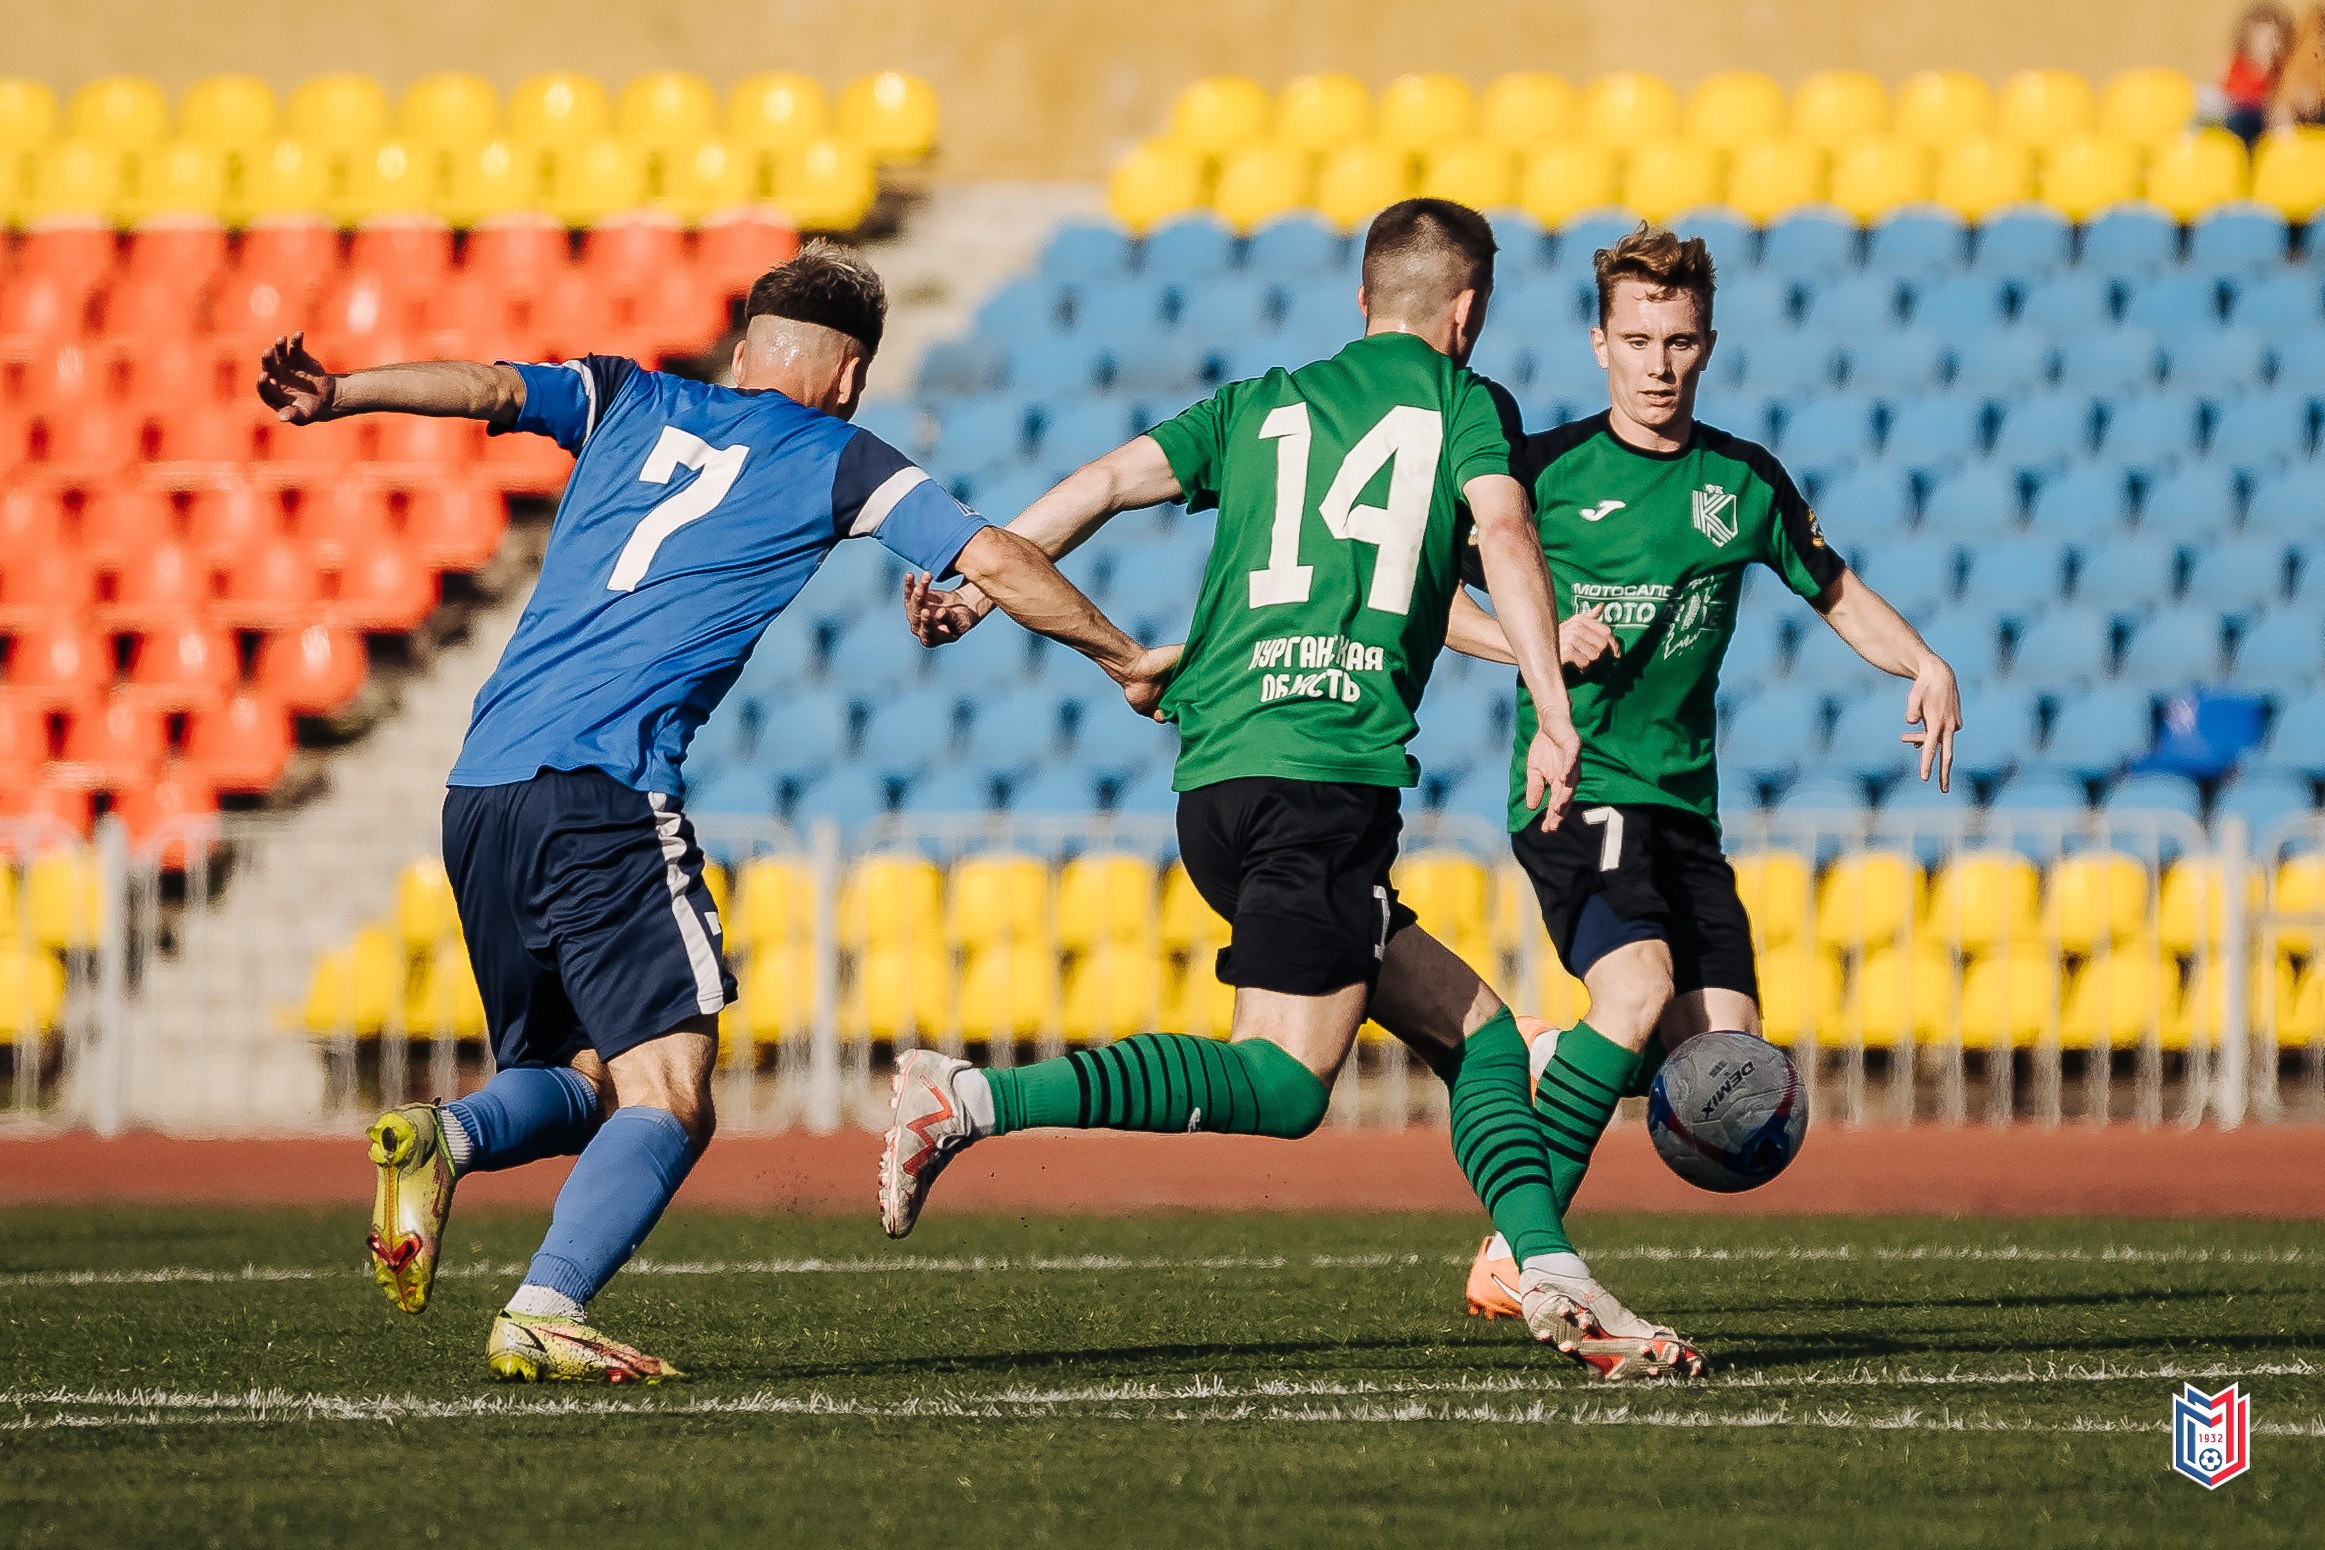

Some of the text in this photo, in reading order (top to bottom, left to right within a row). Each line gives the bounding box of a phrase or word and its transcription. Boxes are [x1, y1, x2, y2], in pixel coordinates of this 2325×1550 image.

[606, 424, 751, 592] 7
[1249, 401, 1443, 616] 14
[1573, 582, 1674, 597] МОТОСАЛО
[1248, 635, 1385, 671] КУРГАНКАЯ
[1582, 805, 1624, 872] 7
[1701, 1061, 1756, 1120] DEMIX
